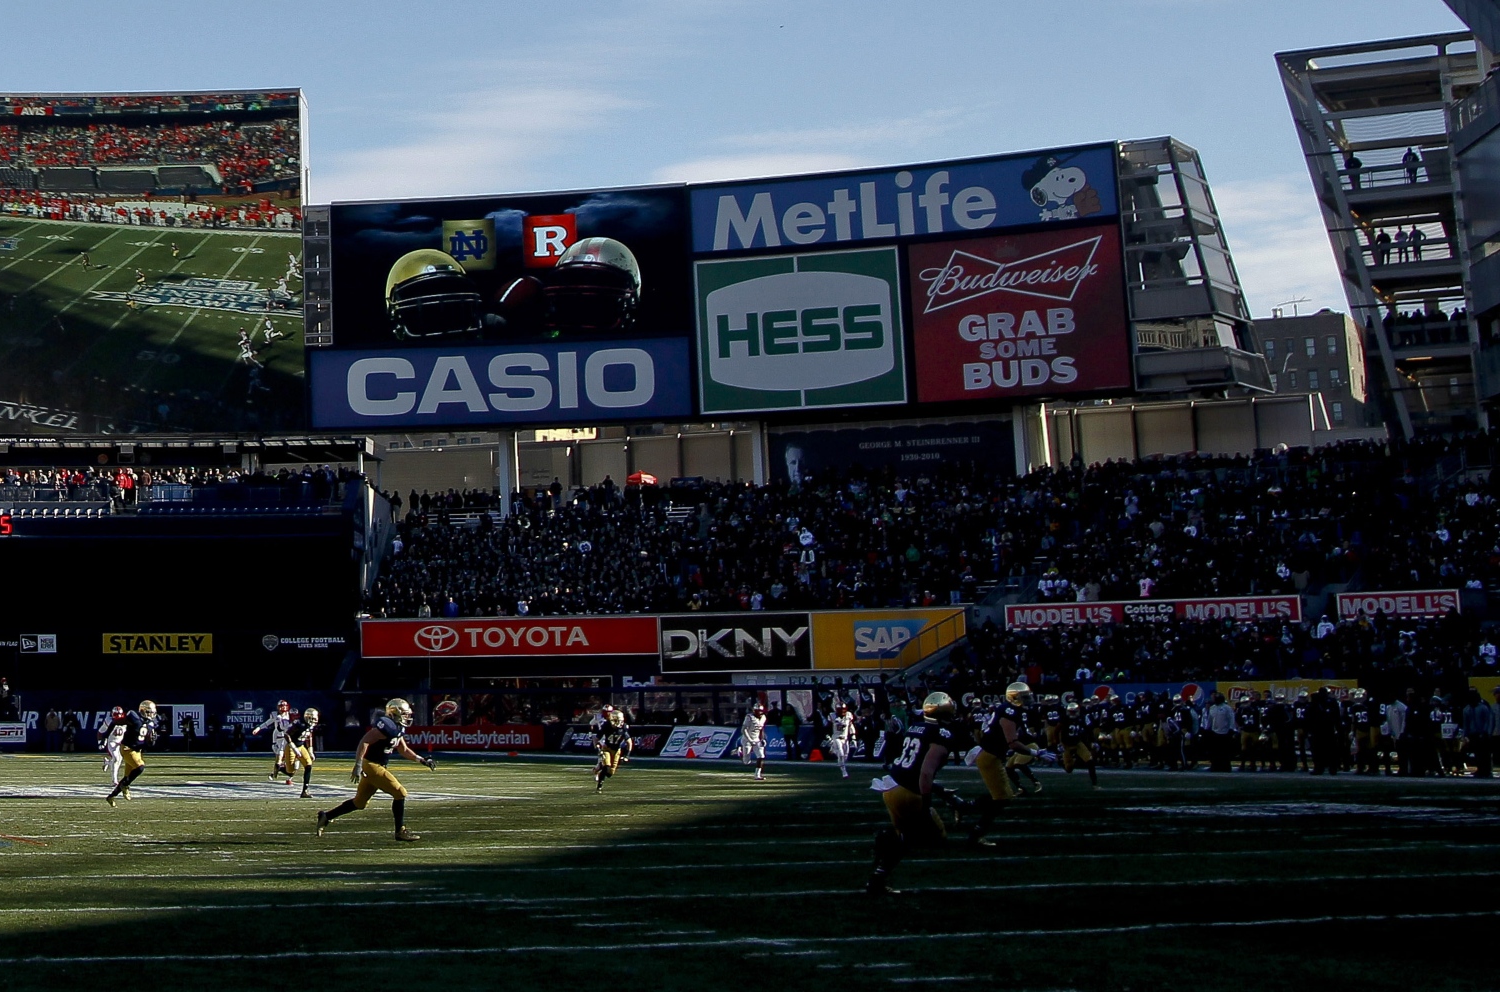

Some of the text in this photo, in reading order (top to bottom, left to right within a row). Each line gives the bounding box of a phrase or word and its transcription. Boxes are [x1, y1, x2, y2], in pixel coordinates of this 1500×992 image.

[20, 106, 46, 116] AVIS
[713, 170, 997, 251] MetLife
[533, 226, 568, 257] R
[919, 260, 1098, 297] Budweiser
[716, 304, 885, 358] HESS
[959, 308, 1076, 342] GRAB
[980, 338, 1057, 359] SOME
[347, 348, 654, 416] CASIO
[963, 356, 1078, 390] BUDS
[859, 441, 892, 449] GEORGE
[906, 437, 969, 447] STEINBRENNER
[0, 515, 13, 535] 5
[1014, 607, 1112, 625] MODELL'S
[1185, 600, 1291, 620] MODELL'S
[1342, 595, 1456, 616] MODELL'S
[110, 635, 205, 652] STANLEY
[464, 626, 590, 648] TOYOTA
[662, 626, 809, 659] DKNY
[855, 626, 911, 653] SAP
[227, 715, 263, 723] PINSTRIPE
[404, 731, 530, 748] ewYork-Presbyterian
